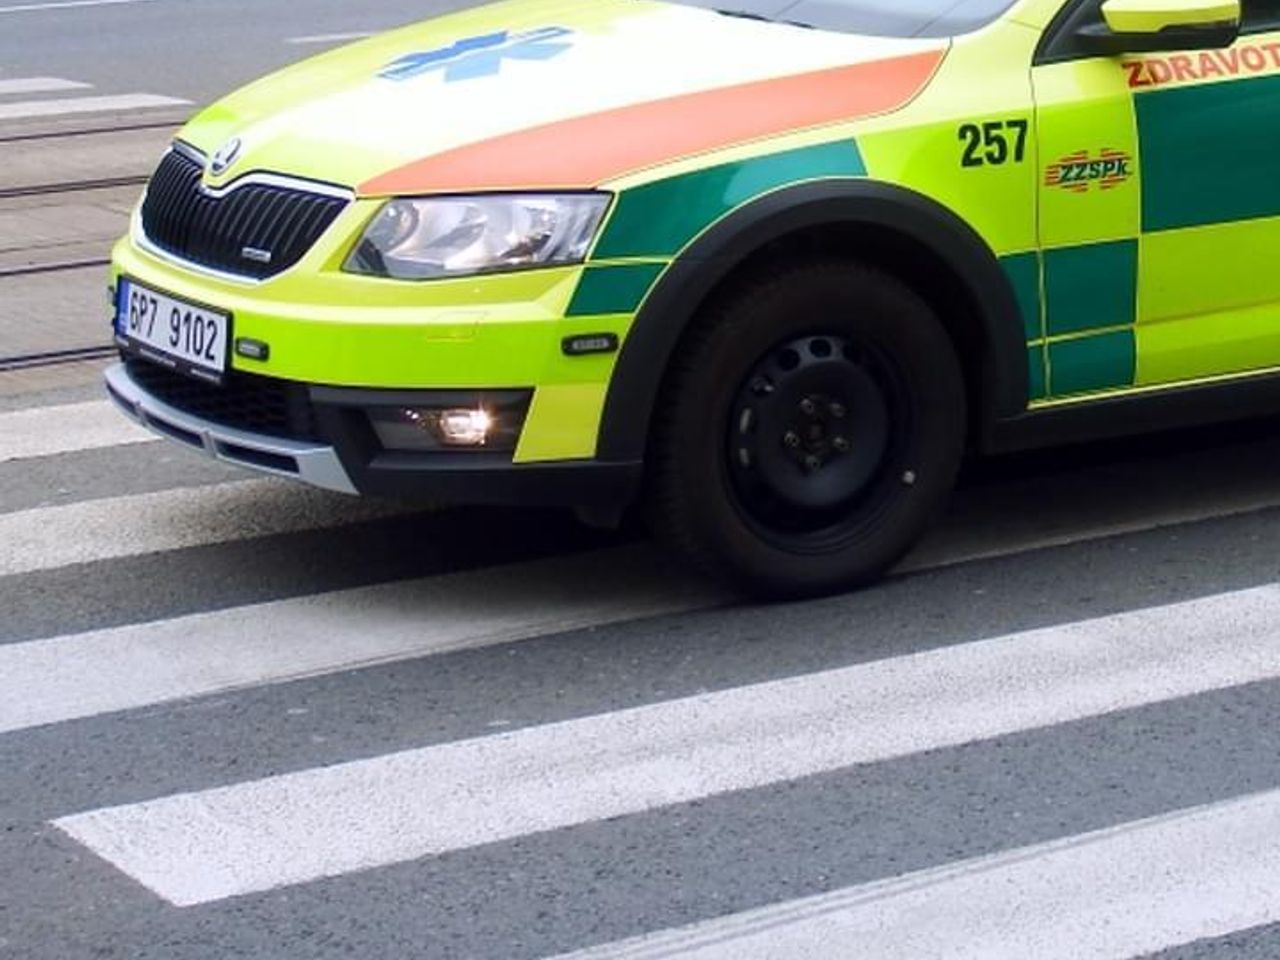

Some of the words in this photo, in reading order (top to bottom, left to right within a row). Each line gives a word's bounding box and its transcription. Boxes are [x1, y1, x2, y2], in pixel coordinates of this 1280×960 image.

[957, 119, 1028, 168] 257
[130, 290, 158, 338] 6P7
[169, 308, 219, 361] 9102
